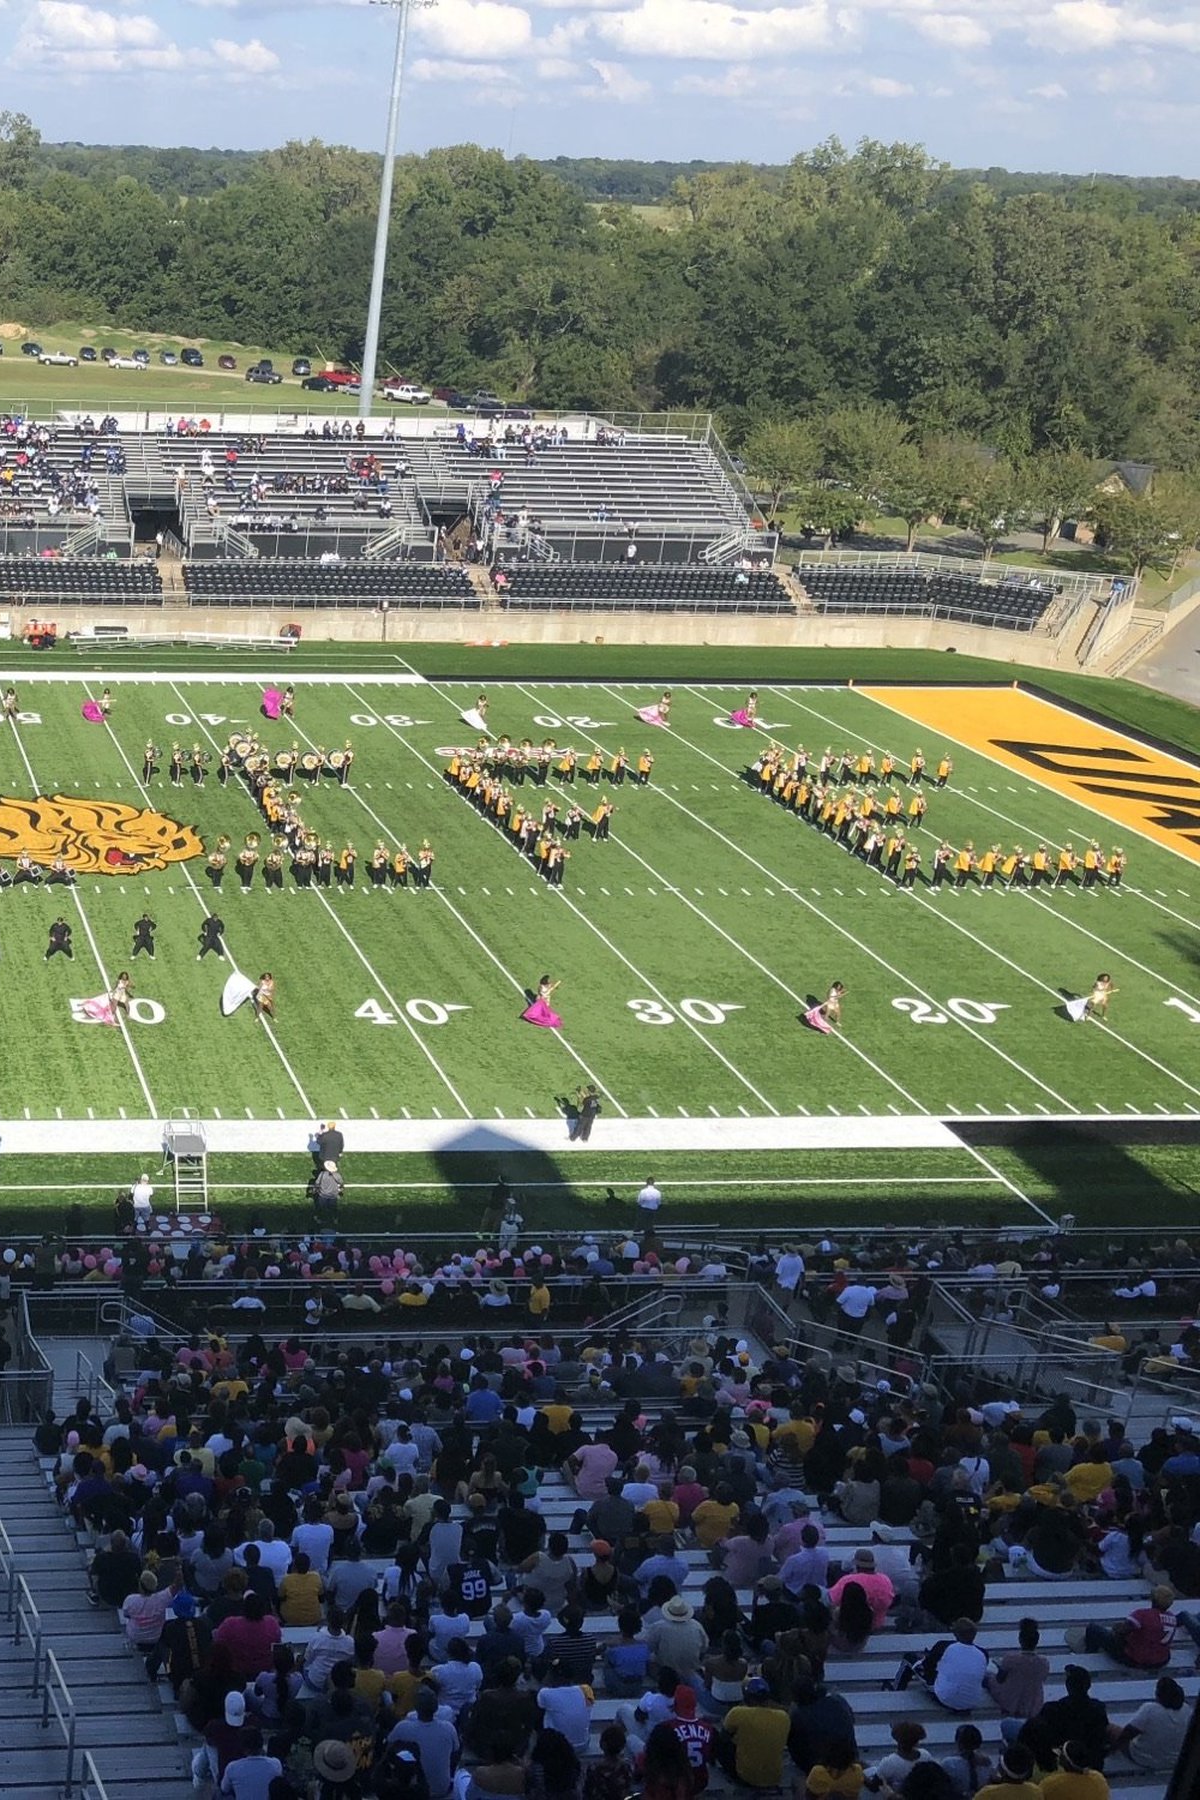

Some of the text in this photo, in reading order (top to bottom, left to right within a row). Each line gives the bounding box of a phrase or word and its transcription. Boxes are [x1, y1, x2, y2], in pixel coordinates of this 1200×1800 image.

[164, 712, 228, 725] 40
[350, 713, 414, 727] 30
[532, 714, 601, 728] 20
[68, 998, 166, 1024] 50
[354, 998, 450, 1025] 40
[626, 998, 726, 1025] 30
[891, 997, 997, 1024] 20
[462, 1578, 486, 1600] 99
[687, 1741, 703, 1768] 5
